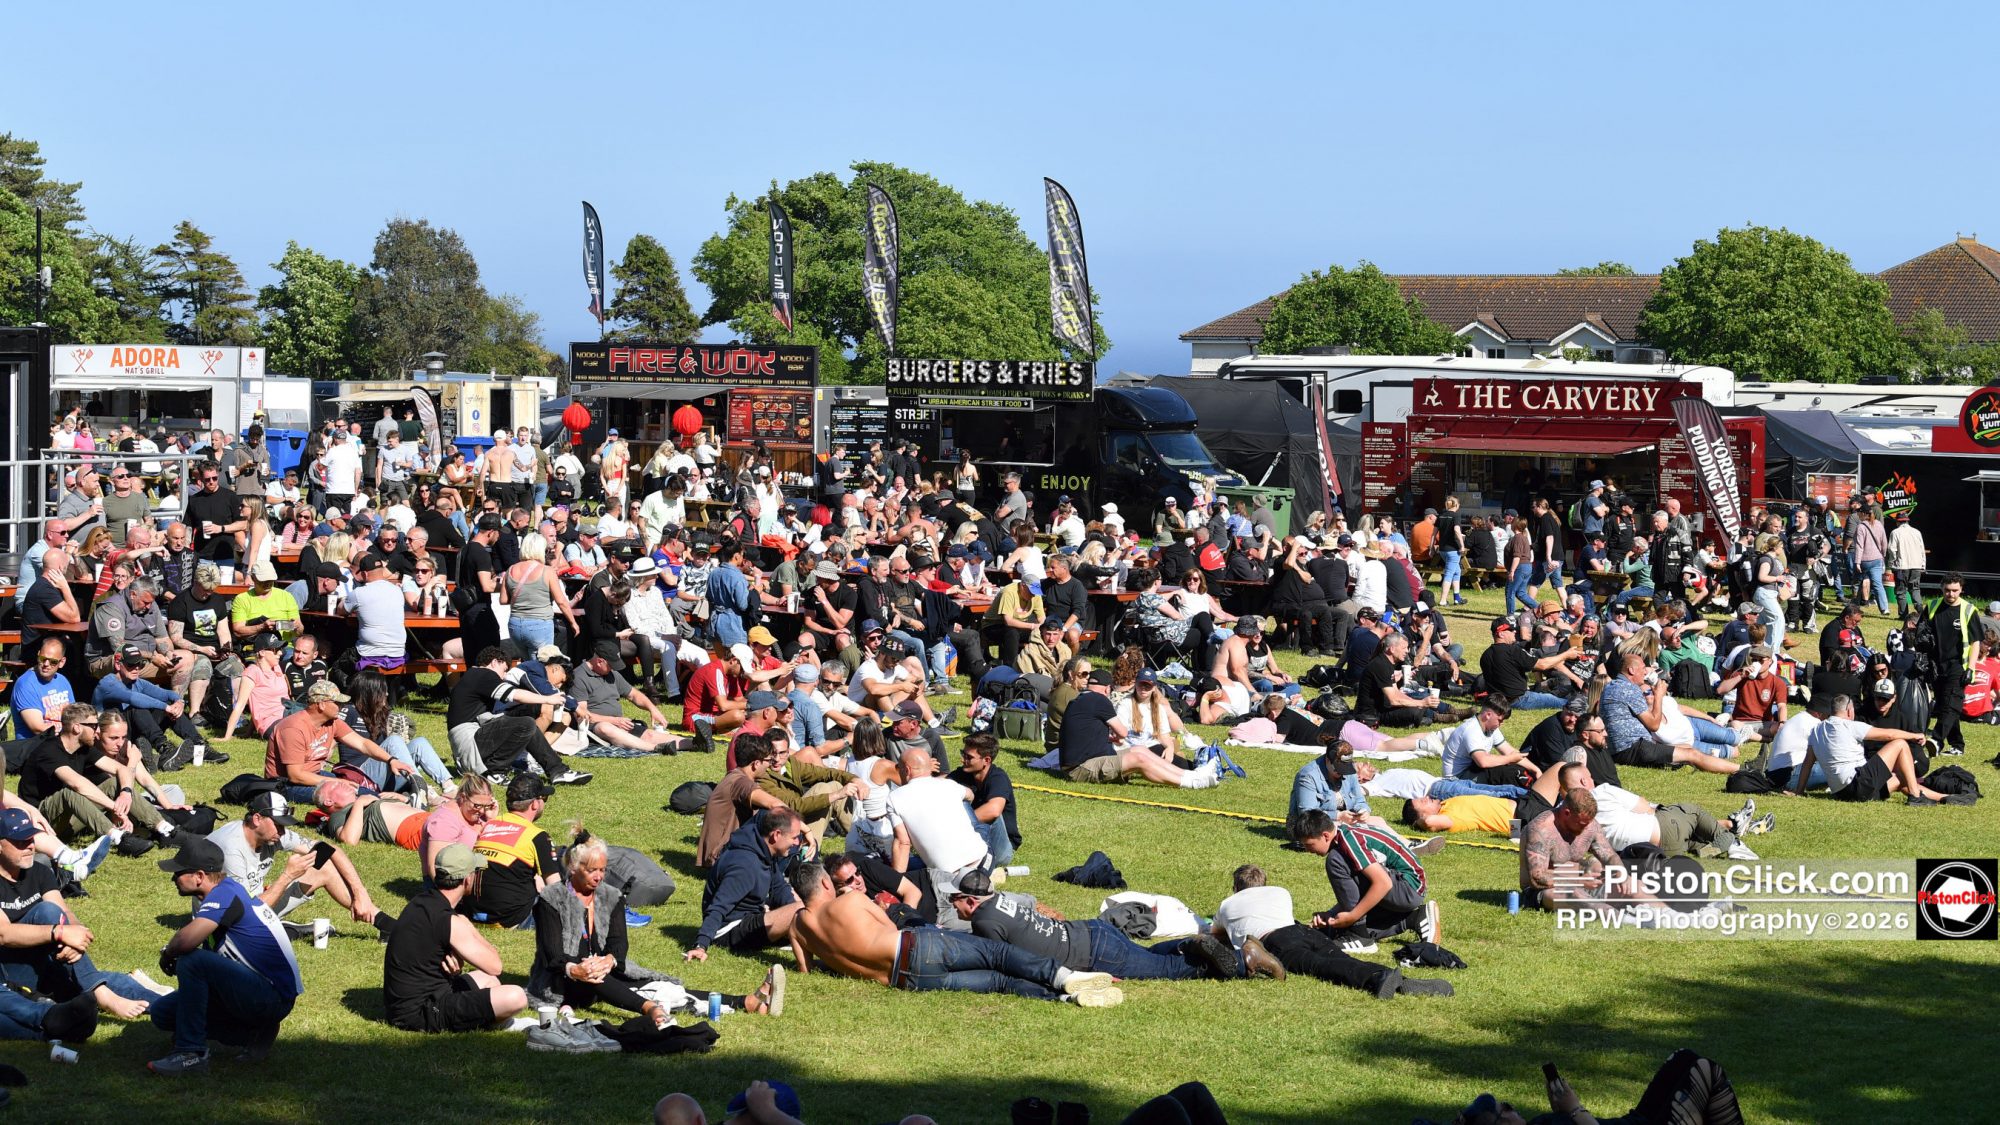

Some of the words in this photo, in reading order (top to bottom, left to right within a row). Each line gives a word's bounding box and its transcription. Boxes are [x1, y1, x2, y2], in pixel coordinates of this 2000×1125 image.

[110, 348, 180, 368] ADORA
[609, 346, 678, 373] FIRE
[679, 347, 698, 374] &
[700, 348, 776, 376] WOK
[889, 360, 992, 383] BURGERS
[997, 362, 1013, 384] &
[1018, 362, 1082, 385] FRIES
[1454, 385, 1512, 409] THE
[1521, 385, 1660, 411] CARVERY
[1978, 413, 1998, 422] yum
[1687, 424, 1723, 492] PUDDING
[1041, 474, 1090, 490] ENJOY
[1884, 490, 1904, 500] yum
